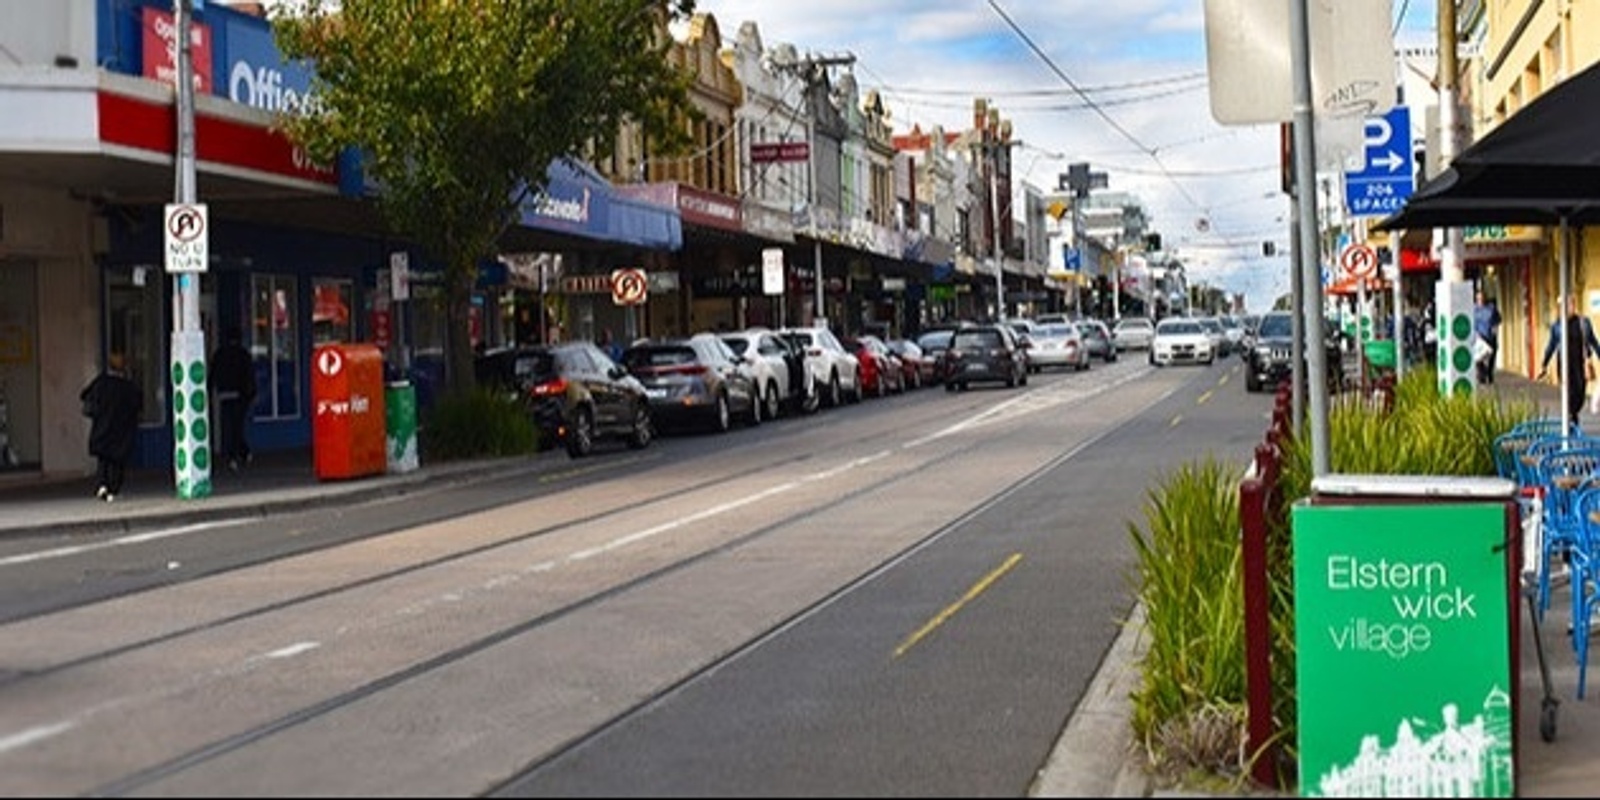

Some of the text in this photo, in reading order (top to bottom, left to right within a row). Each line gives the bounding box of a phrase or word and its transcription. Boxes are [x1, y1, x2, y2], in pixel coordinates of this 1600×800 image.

[1366, 183, 1393, 197] 206
[170, 243, 204, 256] NO U
[172, 256, 202, 268] TURN
[1327, 555, 1447, 589] Elstern
[1392, 587, 1477, 619] wick
[1328, 618, 1432, 659] village
